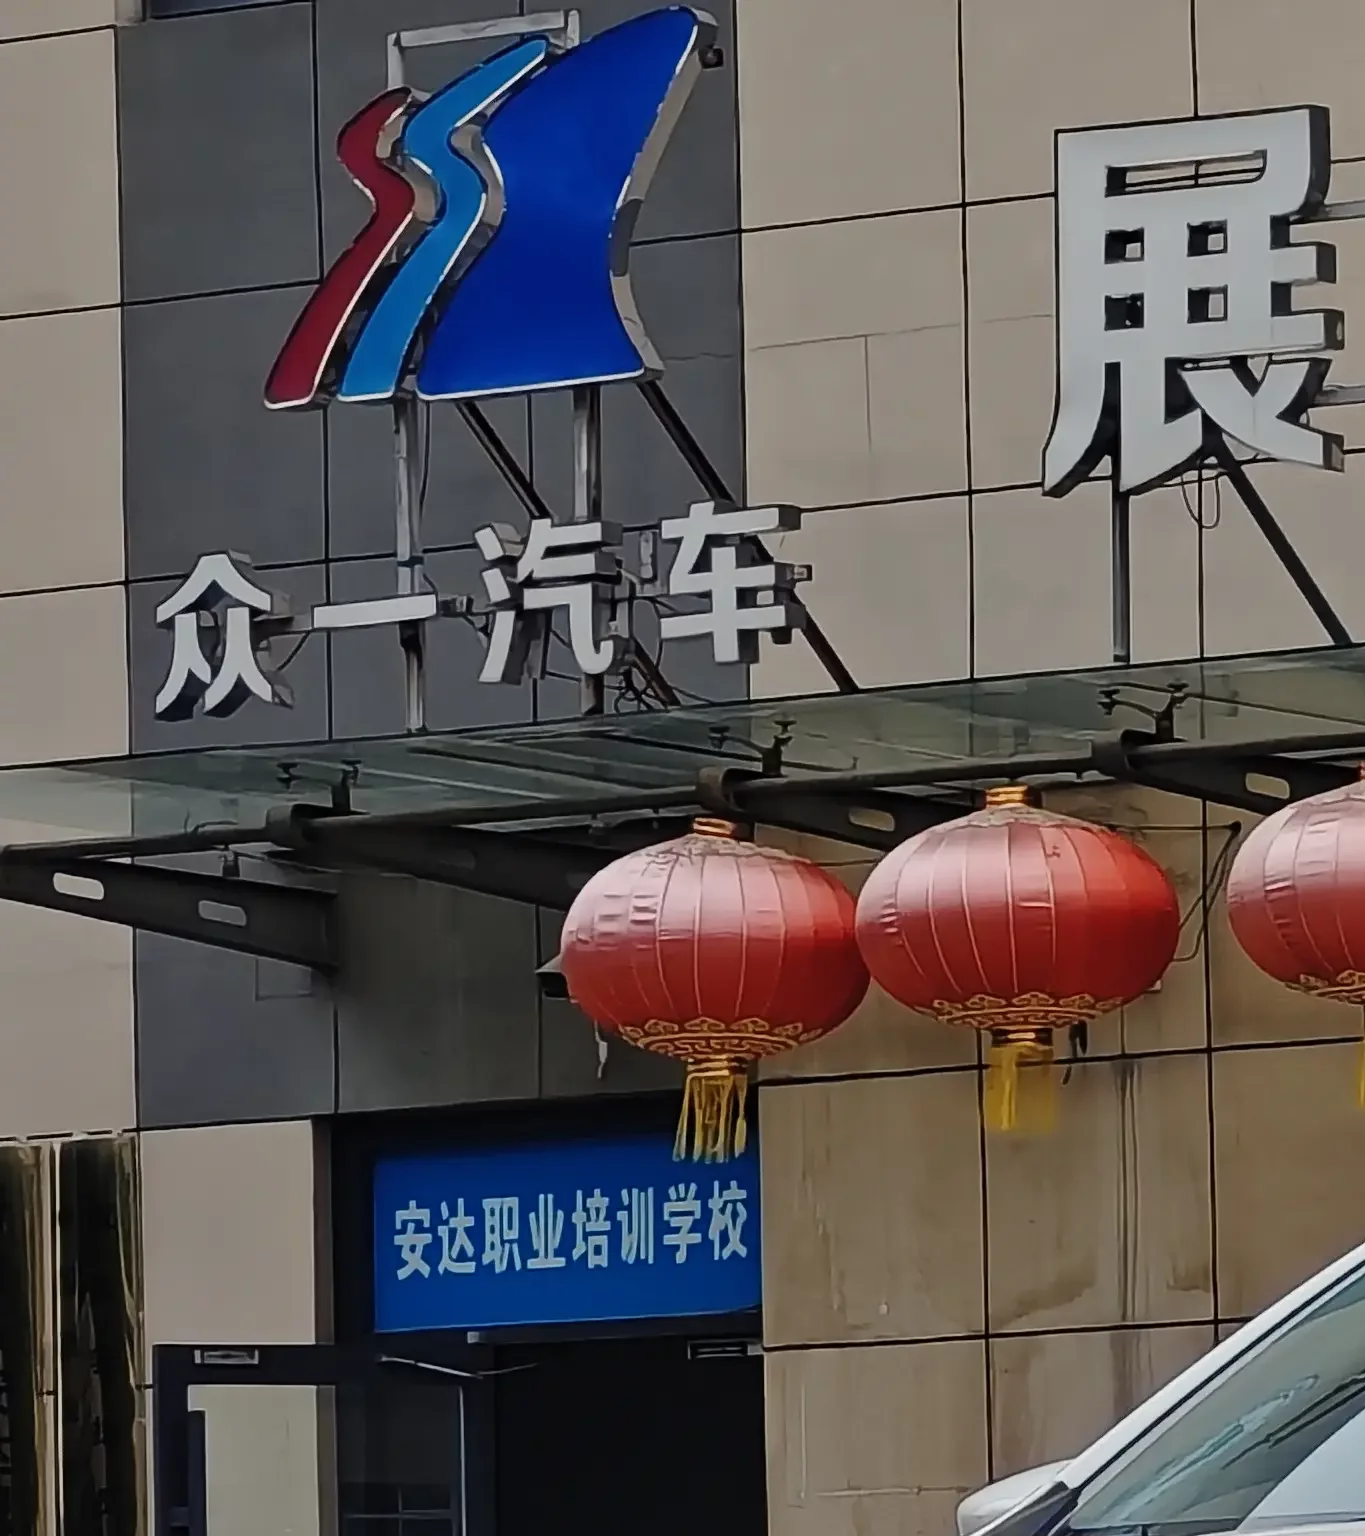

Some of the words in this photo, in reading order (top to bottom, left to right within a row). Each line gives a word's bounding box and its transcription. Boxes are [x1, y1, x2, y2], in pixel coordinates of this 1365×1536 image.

[154, 502, 790, 716] 众一汽车
[393, 1179, 749, 1281] 安达职业培训学校
